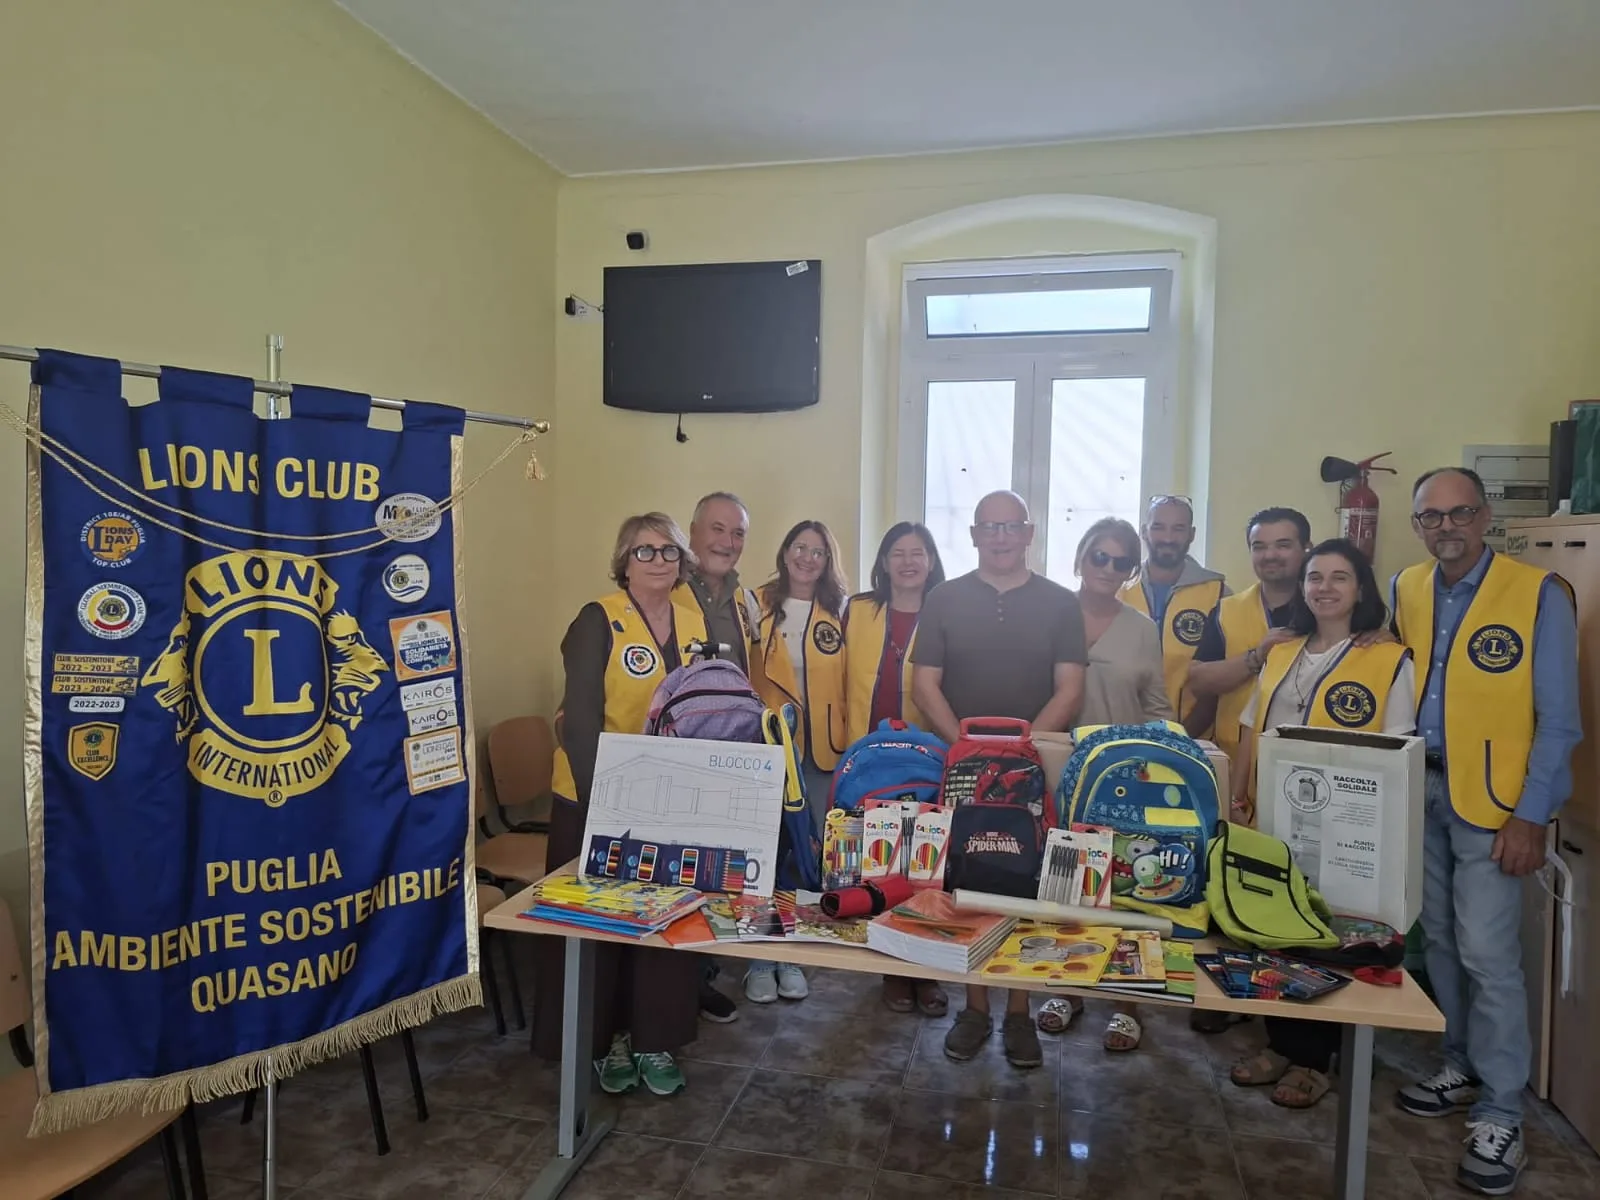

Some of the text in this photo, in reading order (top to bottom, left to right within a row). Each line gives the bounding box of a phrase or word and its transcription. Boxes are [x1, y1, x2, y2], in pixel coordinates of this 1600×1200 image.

[138, 444, 380, 502] LIONS CLUB
[105, 535, 132, 544] DAY
[92, 557, 132, 569] TOP CLUB
[188, 557, 336, 609] LIONS
[243, 629, 315, 716] L
[74, 700, 120, 708] 2022-2023
[193, 738, 340, 789] INTERNATIONAL
[709, 755, 772, 771] BLOCCO 4
[1333, 775, 1377, 787] RACCOLTA
[1337, 782, 1377, 793] SOLIDALE
[966, 840, 1021, 855] SPIDER-MAN
[1159, 849, 1191, 869] HI!
[205, 848, 343, 897] PUGLIA
[52, 857, 464, 972] AMBIENTE SOSTENIBILE
[190, 942, 358, 1013] QUASANO
